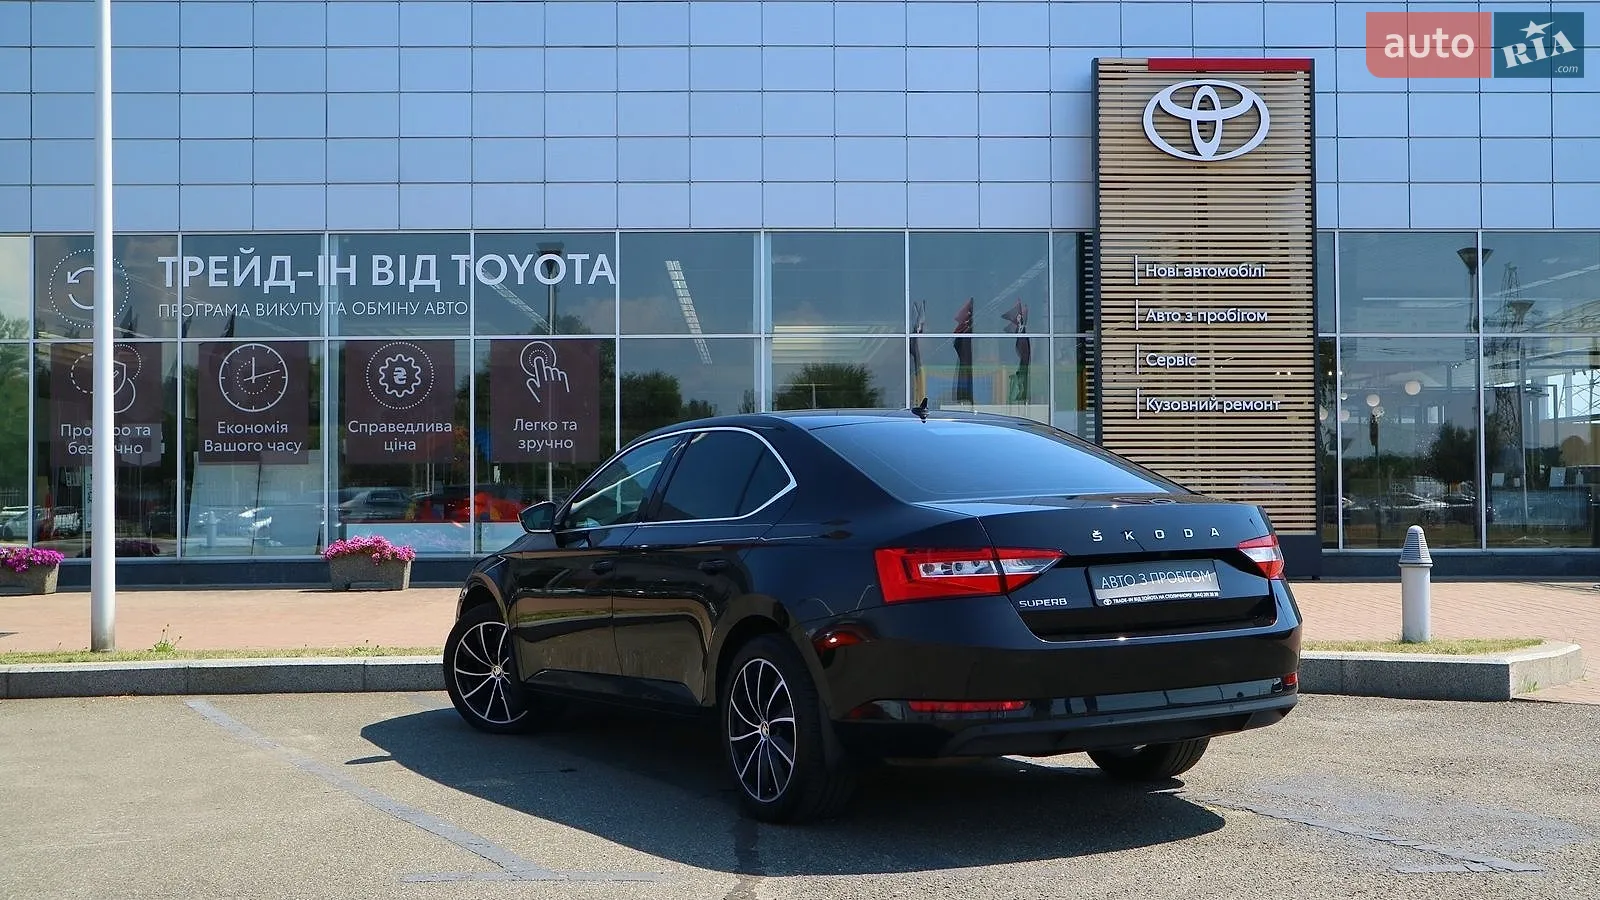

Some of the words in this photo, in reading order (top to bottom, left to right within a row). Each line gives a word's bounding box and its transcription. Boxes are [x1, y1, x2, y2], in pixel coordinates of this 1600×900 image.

[157, 247, 357, 294] ТРЕЙД-ІН
[371, 254, 441, 293] ВІД
[451, 253, 617, 286] TOYOTA
[1145, 264, 1179, 278] Нові
[1185, 263, 1266, 278] автомобілі
[158, 302, 251, 318] ПРОГРАМА
[255, 301, 323, 317] ВИКУПУ
[327, 301, 347, 316] ТА
[351, 301, 420, 316] ОБМІНУ
[424, 301, 469, 315] АВТО
[1145, 308, 1181, 322] Авто
[1184, 311, 1194, 322] з
[1197, 308, 1269, 325] пробігом
[1145, 353, 1198, 369] Сервіс
[1145, 396, 1218, 414] Кузовний
[1223, 400, 1281, 413] ремонт
[60, 423, 131, 440] Проо
[135, 426, 151, 436] та
[217, 420, 288, 434] Економія
[348, 420, 453, 436] Справедлива
[512, 418, 558, 431] Легко
[562, 420, 578, 431] та
[68, 441, 143, 455] безчно
[204, 439, 263, 452] Вашого
[267, 441, 302, 455] часу
[384, 437, 417, 453] ціна
[517, 438, 574, 452] зручно
[1101, 574, 1136, 589] АВТО
[1149, 569, 1212, 585] ПРОБІГОМ
[1018, 597, 1068, 608] SUPERB
